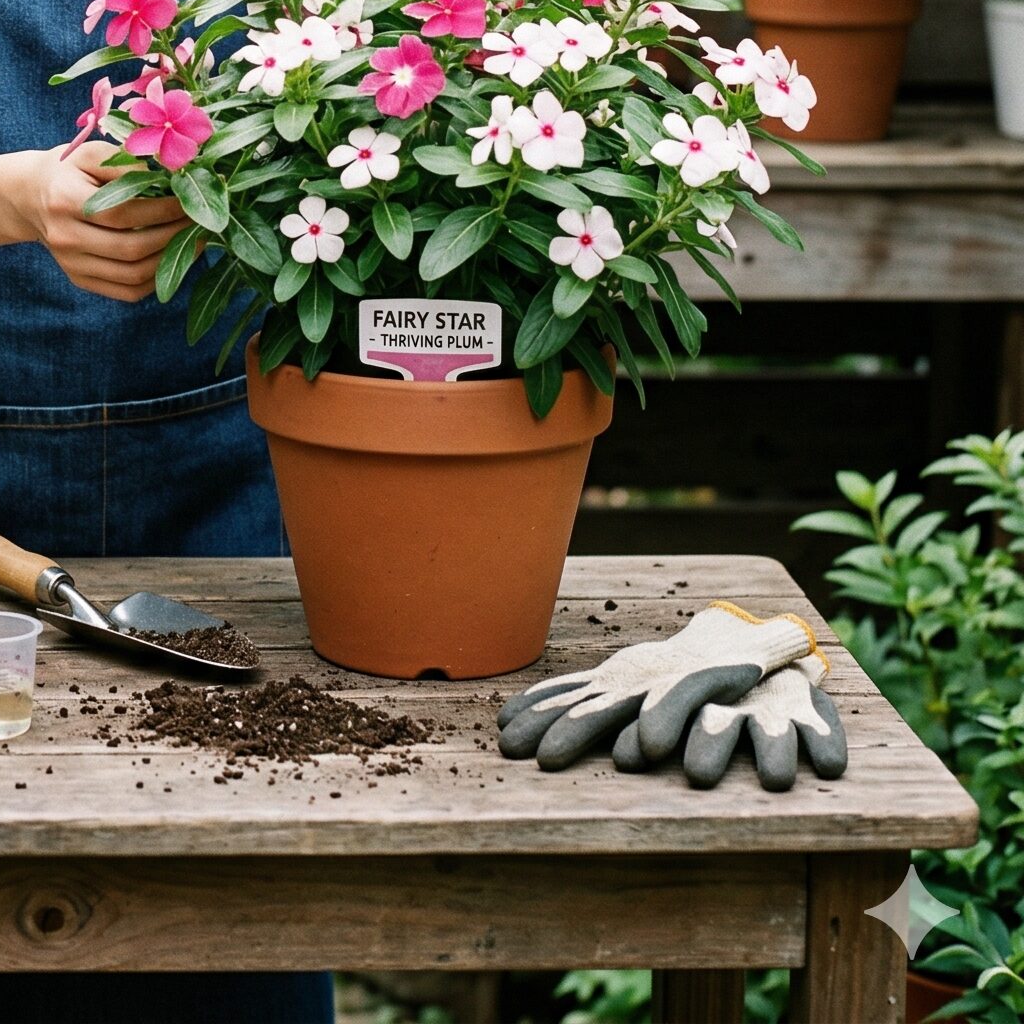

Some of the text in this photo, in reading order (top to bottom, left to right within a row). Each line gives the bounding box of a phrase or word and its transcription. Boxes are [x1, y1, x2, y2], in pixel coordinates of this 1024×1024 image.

[373, 310, 486, 330] FAIRY STAR
[381, 334, 483, 348] THRIVING PLUM
